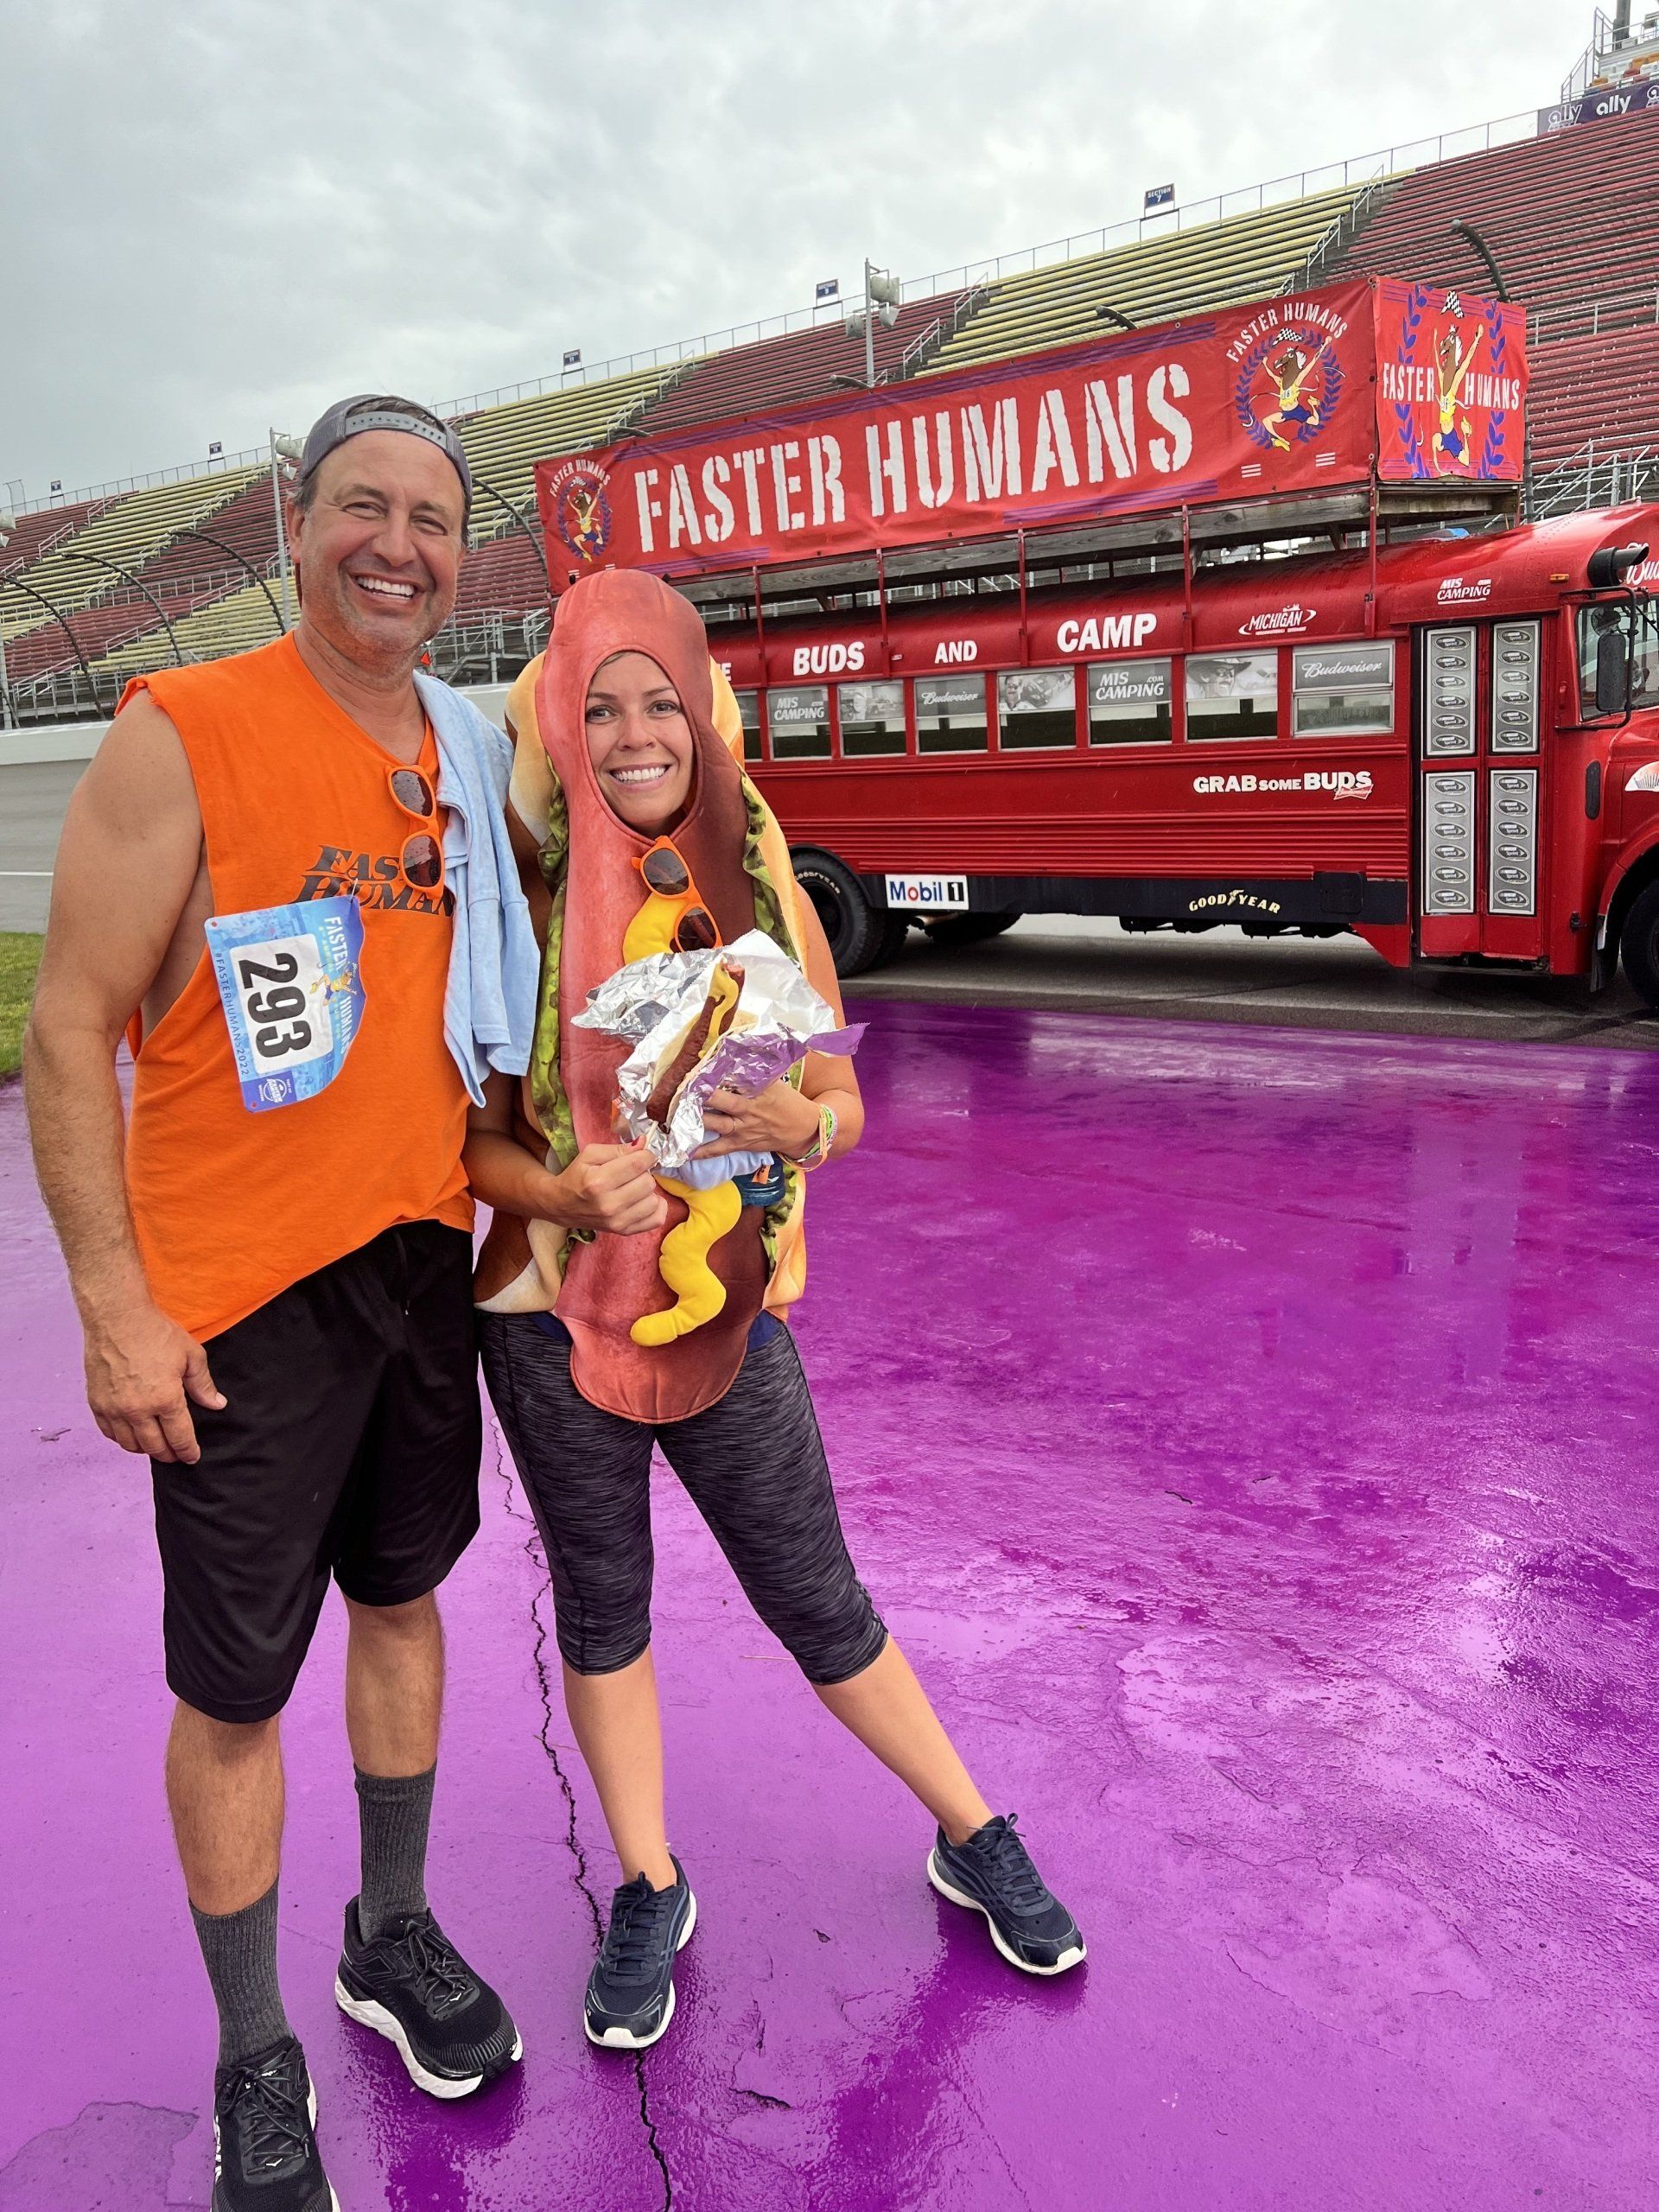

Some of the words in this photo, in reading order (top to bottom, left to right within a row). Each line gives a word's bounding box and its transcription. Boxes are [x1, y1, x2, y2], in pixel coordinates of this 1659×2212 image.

[1596, 94, 1631, 116] ally
[1226, 308, 1279, 363] FASTER
[1283, 302, 1348, 339] HUMANS
[1382, 362, 1435, 403] FASTER
[1464, 372, 1521, 410] HUMANS
[634, 435, 846, 553] FASTER
[865, 363, 1192, 517] HUMANS
[550, 461, 575, 498] FASTER
[575, 459, 611, 486] HUMANS
[1437, 585, 1491, 600] CAMPING
[1440, 577, 1463, 589] MIS
[1249, 611, 1303, 631] MICHIGAN
[793, 641, 865, 676] BUDS
[934, 640, 978, 664] AND
[1057, 613, 1157, 652] CAMP
[1100, 671, 1128, 687] MIS
[1301, 660, 1382, 678] Budweiser
[777, 696, 798, 709] MIS
[921, 691, 979, 705] Budweiser
[1095, 683, 1165, 701] CAMPING
[773, 707, 824, 721] CAMPING
[1192, 774, 1257, 793] GRAB
[1258, 779, 1302, 791] SOME
[1304, 771, 1372, 791] BUDS
[889, 881, 943, 901] Mobil
[949, 882, 963, 901] 1
[325, 917, 348, 971] FASTER
[215, 952, 250, 1075] #FASTERHUMANS2022
[238, 953, 312, 1058] 293
